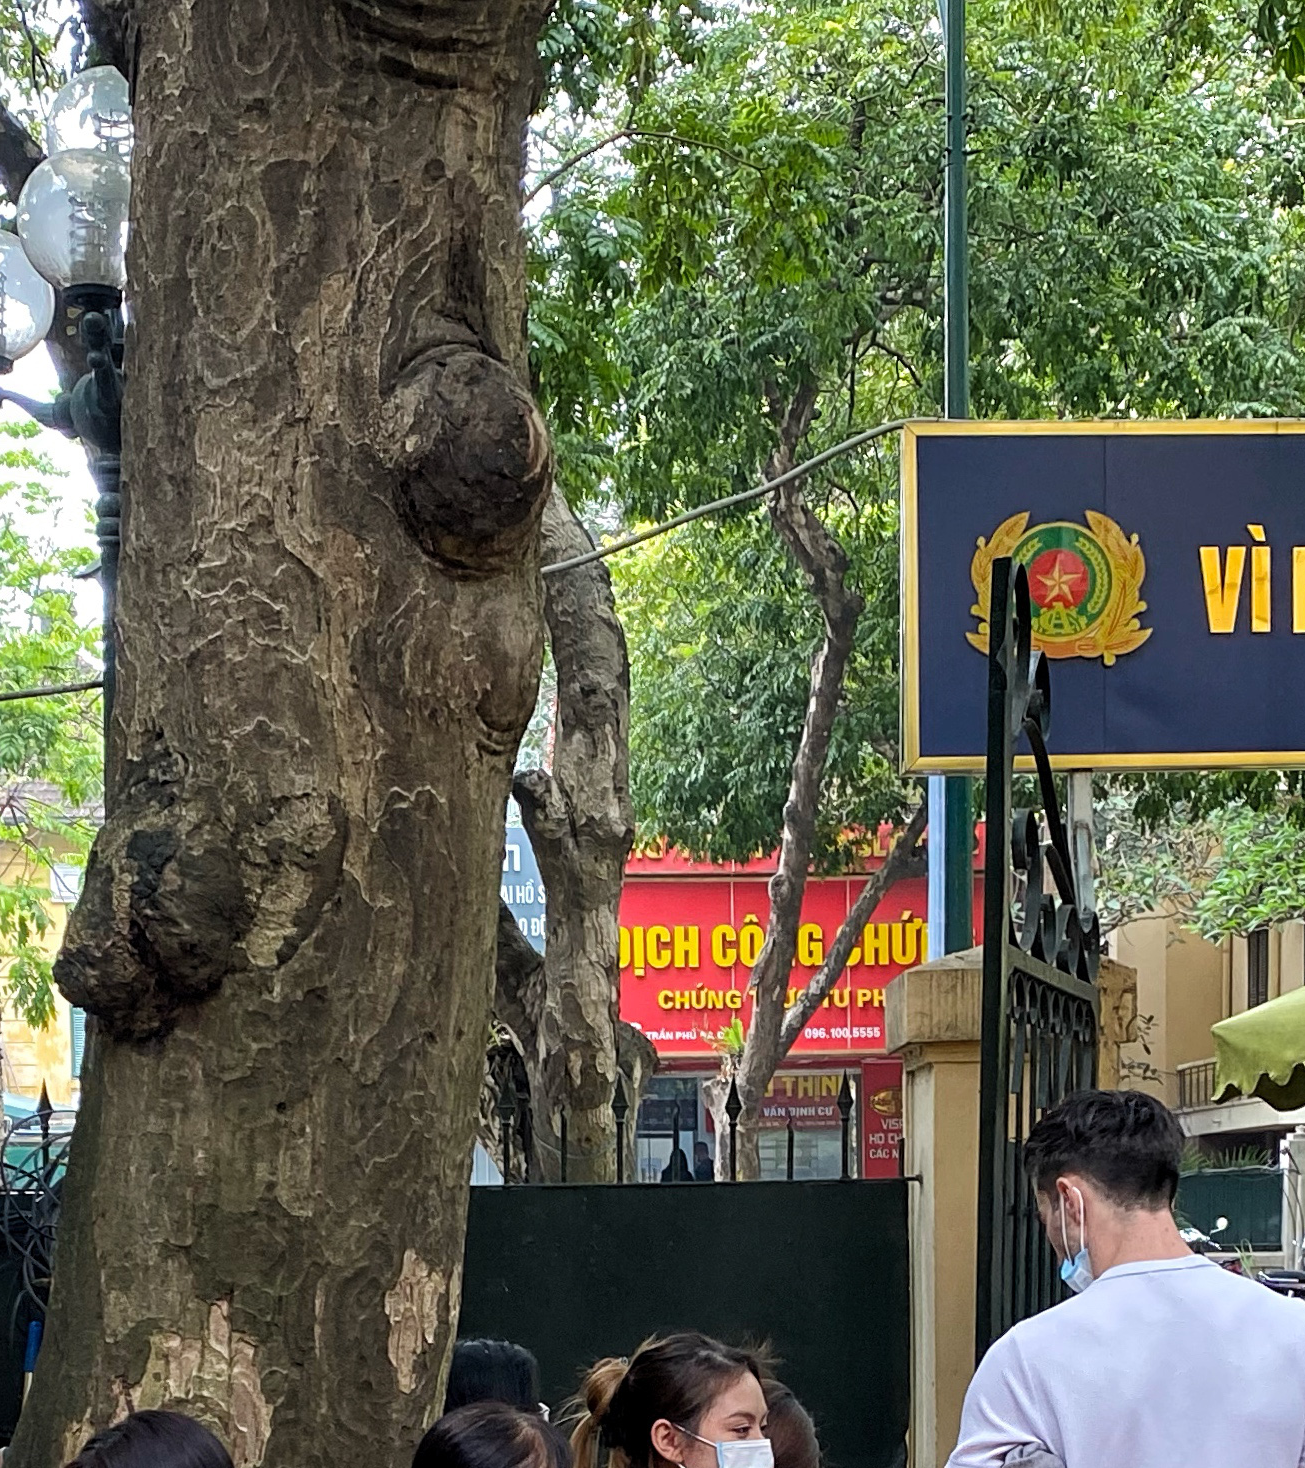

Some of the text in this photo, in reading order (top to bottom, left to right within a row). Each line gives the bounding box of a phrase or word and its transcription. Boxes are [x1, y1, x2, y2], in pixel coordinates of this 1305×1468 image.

[1198, 523, 1271, 634] VÌ
[515, 878, 535, 905] HỒ
[711, 914, 823, 968] CÔG
[658, 983, 742, 1010] CHỨNG
[804, 1027, 881, 1039] 096.100.5555
[781, 1075, 842, 1102] THỊN
[869, 1147, 890, 1159] CÁC
